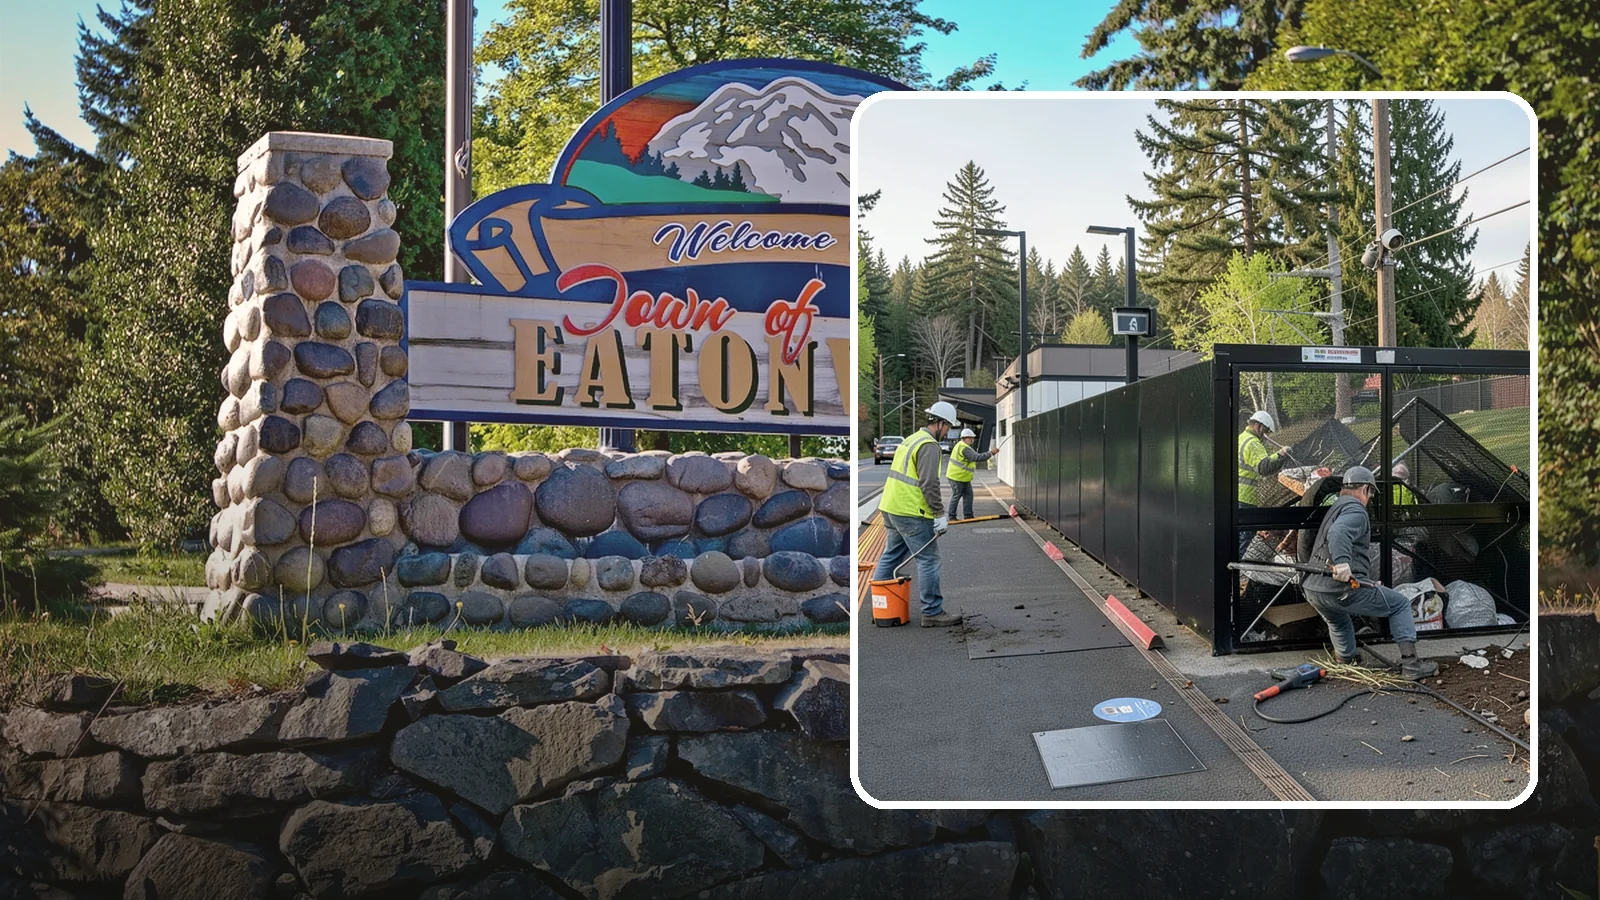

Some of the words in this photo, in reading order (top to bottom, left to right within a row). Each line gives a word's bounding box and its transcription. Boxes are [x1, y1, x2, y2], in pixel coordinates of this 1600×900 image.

[653, 221, 835, 262] Welcome
[557, 264, 736, 335] Town
[765, 279, 825, 363] of
